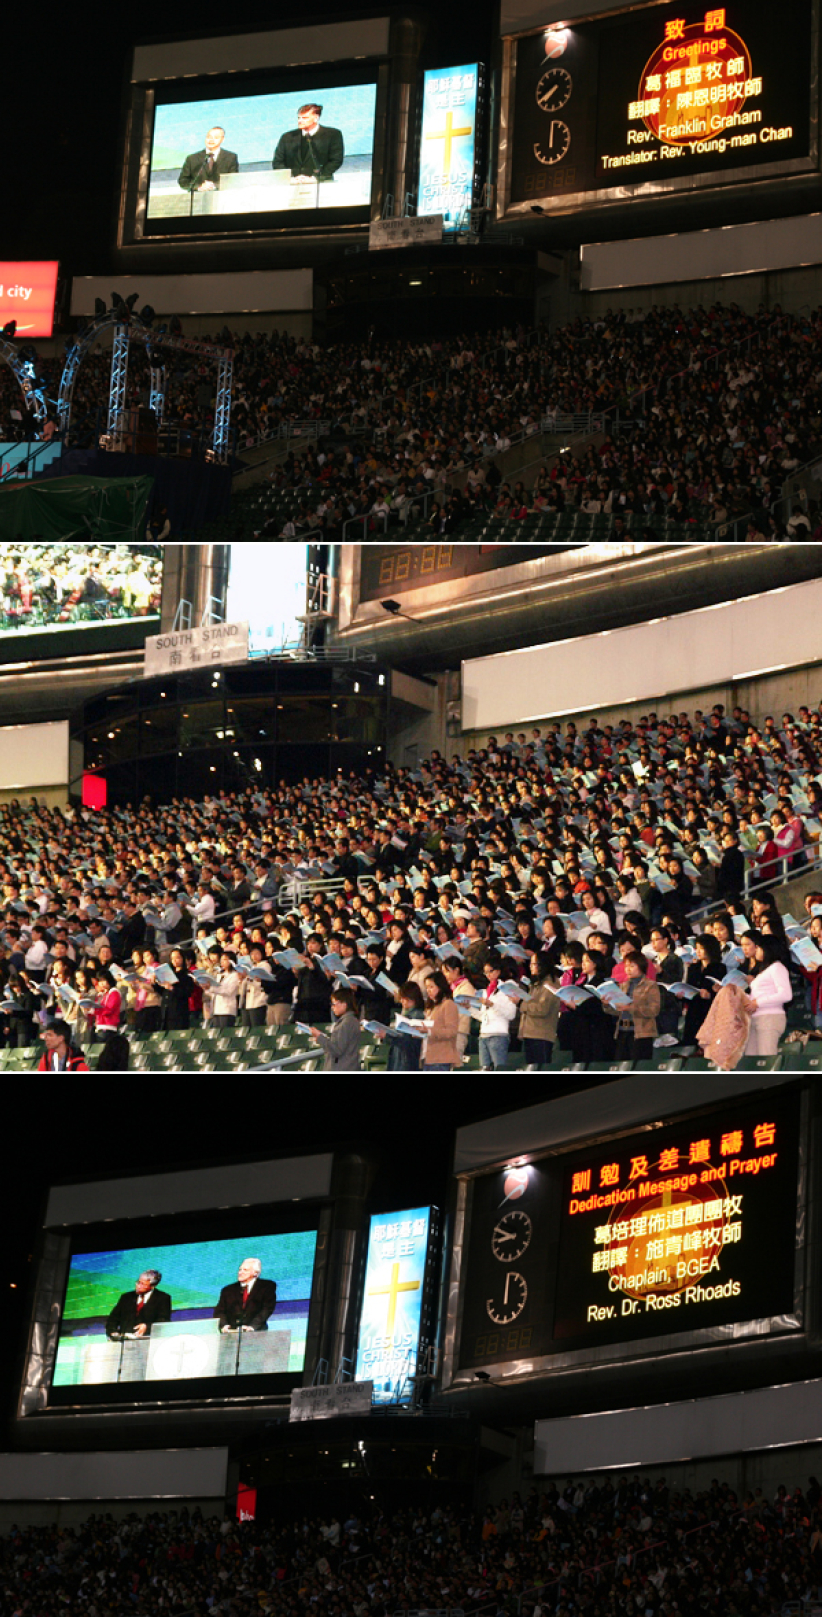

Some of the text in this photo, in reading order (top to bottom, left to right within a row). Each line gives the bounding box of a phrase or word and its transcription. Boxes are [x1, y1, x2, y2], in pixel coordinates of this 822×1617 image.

[665, 8, 726, 40] 致詞
[662, 37, 727, 62] Greetings
[627, 110, 762, 145] Rev. Franklin Graham
[660, 144, 685, 159] Rev.
[689, 132, 757, 153] Young-man
[760, 126, 793, 143] Chan
[423, 171, 468, 187] JESUS
[423, 183, 468, 196] CHRIST
[422, 197, 432, 211] IS
[377, 217, 435, 230] SOUTH STAND
[7, 284, 33, 301] city
[156, 625, 239, 649] SOUTH STAND
[569, 1152, 778, 1215] Dedication Message and Prayer
[608, 1255, 720, 1292] Chaplain, BGEA
[587, 1278, 741, 1322] Rev. Dr. Ross Rhoads
[363, 1332, 413, 1352] JESUS
[362, 1347, 412, 1364] CHRIST
[361, 1363, 373, 1379] IS
[300, 1384, 364, 1399] SOUTH STAND
